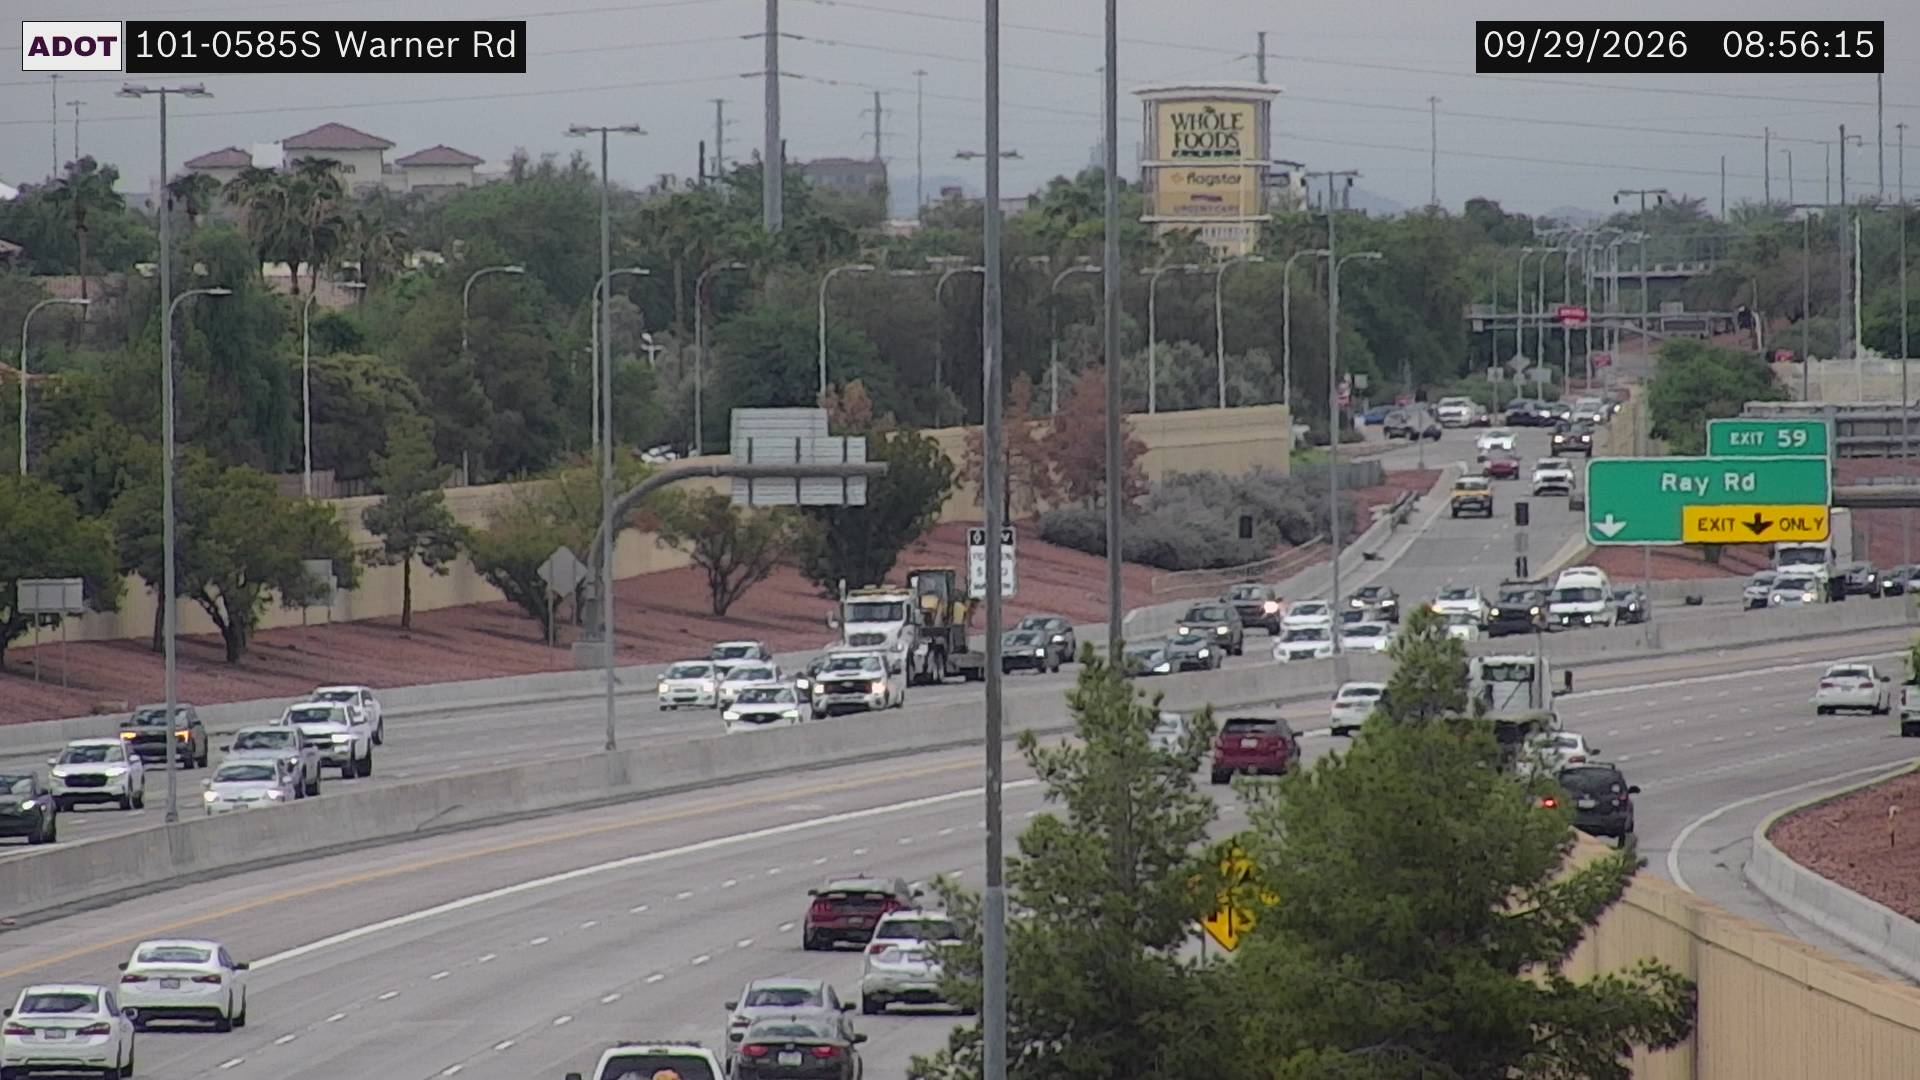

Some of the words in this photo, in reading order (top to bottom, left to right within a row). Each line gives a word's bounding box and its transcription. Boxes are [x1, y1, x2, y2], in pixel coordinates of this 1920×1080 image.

[1170, 112, 1245, 131] WHOLE
[1174, 132, 1240, 149] FOODS
[1730, 431, 1765, 445] EXIT
[1777, 429, 1807, 448] 59
[1661, 472, 1709, 497] Ray
[1724, 472, 1756, 491] Rd
[1697, 518, 1735, 532] EXIT
[1779, 517, 1824, 532] ONLY
